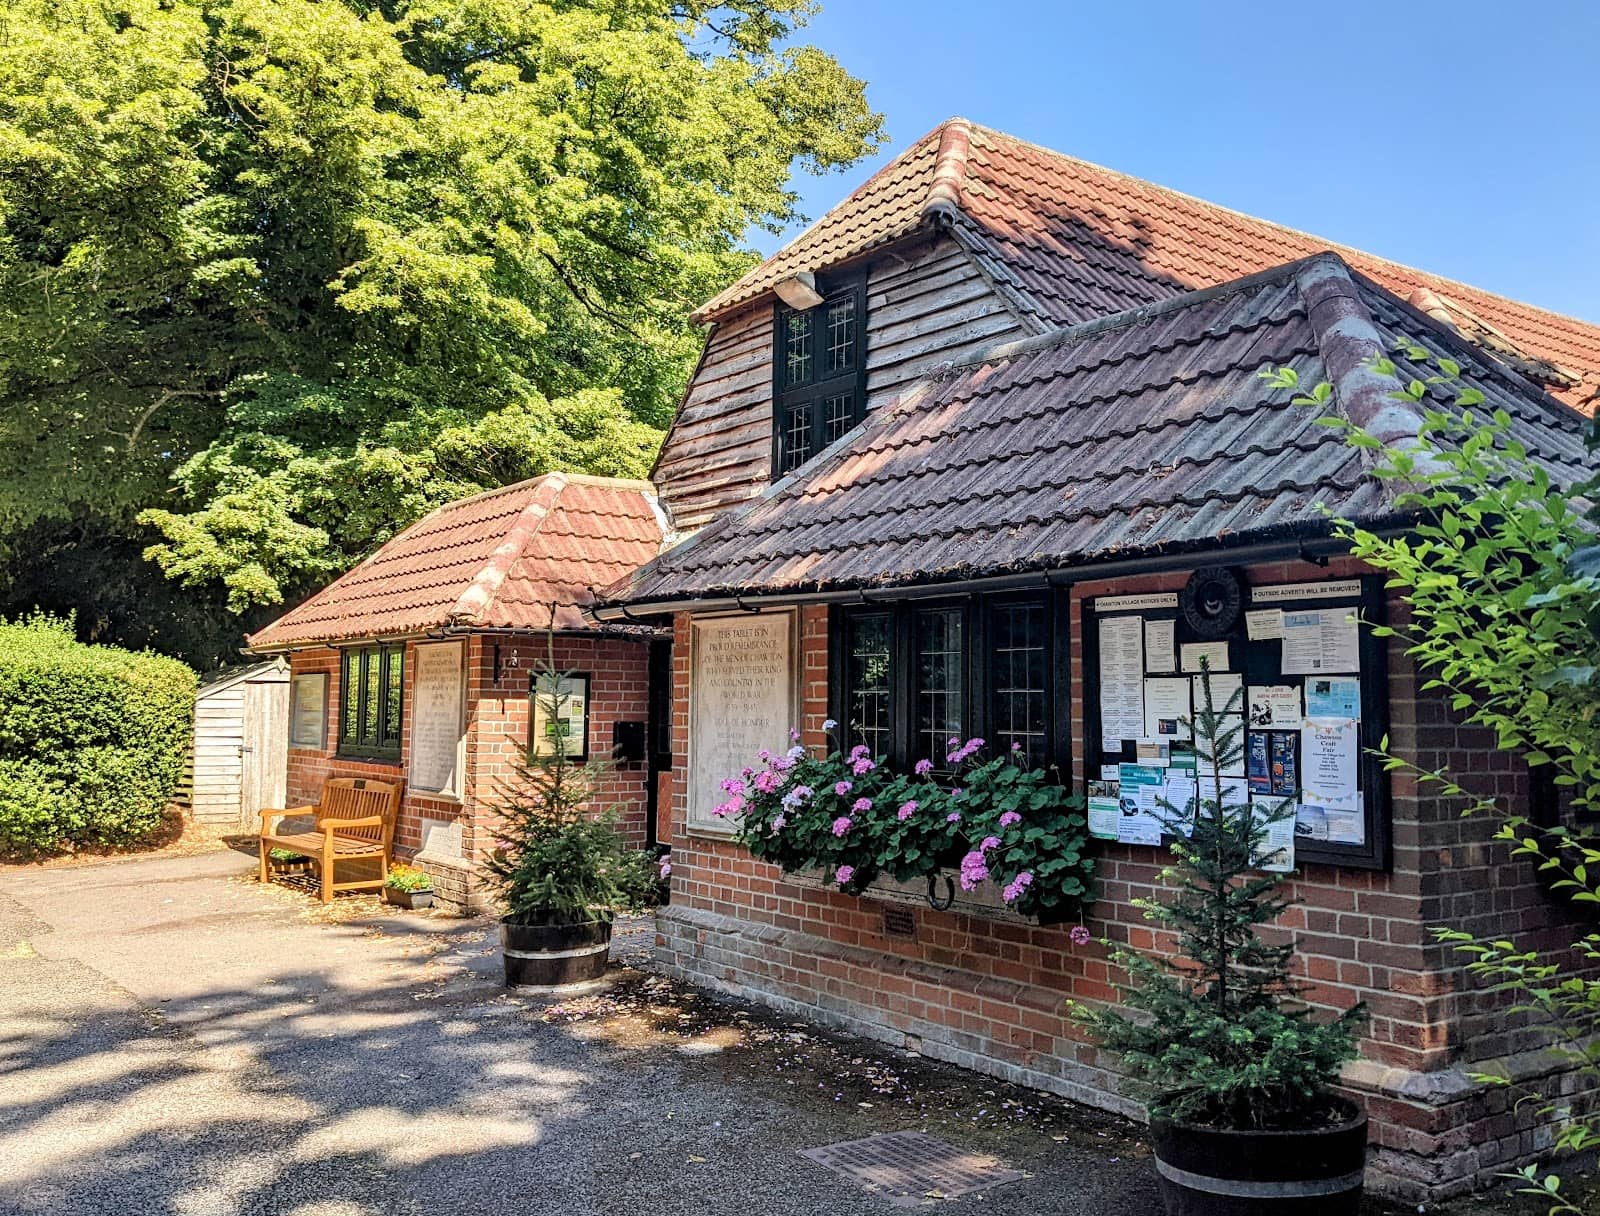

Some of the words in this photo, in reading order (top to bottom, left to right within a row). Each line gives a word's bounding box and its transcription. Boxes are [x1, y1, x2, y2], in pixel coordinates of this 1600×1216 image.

[1280, 588, 1305, 596] ADVERTS
[1328, 585, 1357, 593] REMOVED
[1160, 596, 1173, 604] ONLY
[718, 630, 731, 639] THIS
[733, 628, 753, 637] TABLET
[754, 628, 760, 637] IS
[761, 627, 769, 636] IN
[709, 642, 730, 652] PROUD
[731, 639, 777, 650] REMEMBRANCE
[703, 655, 712, 664] OF
[714, 655, 723, 664] THE
[725, 654, 740, 663] MEN
[740, 654, 748, 662] OF
[750, 652, 783, 662] CHAWTON
[722, 665, 745, 675] SERVED
[765, 664, 782, 674] KING
[723, 678, 753, 687] COUNTRY
[755, 678, 763, 686] IN
